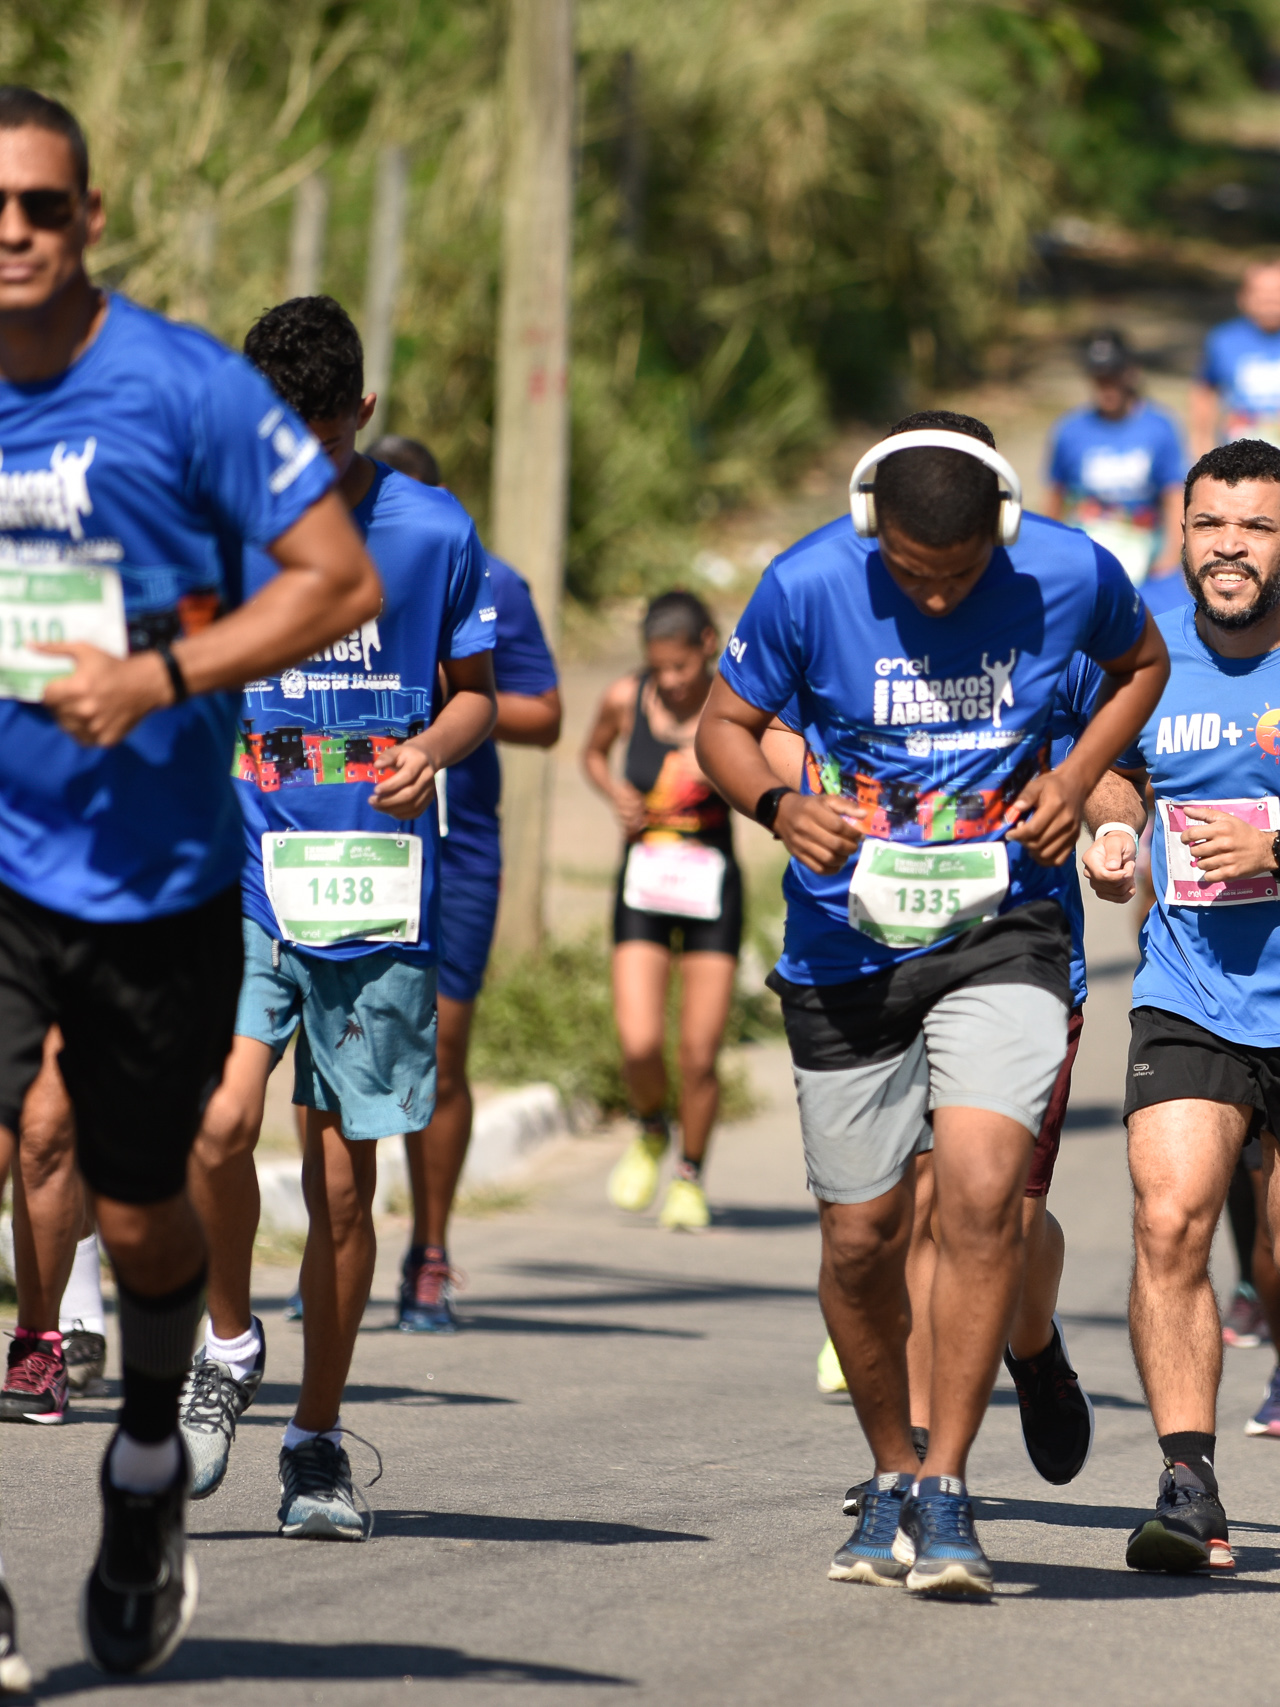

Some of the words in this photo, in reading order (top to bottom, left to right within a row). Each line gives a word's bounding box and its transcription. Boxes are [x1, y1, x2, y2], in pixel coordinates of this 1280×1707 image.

[874, 654, 931, 677] enel
[307, 680, 331, 691] RIO
[332, 680, 349, 690] DE
[350, 680, 401, 691] JANEIRO
[890, 698, 992, 726] ABERTOS
[1155, 712, 1243, 755] AMD+
[308, 877, 374, 906] 1438
[895, 887, 961, 915] 1335
